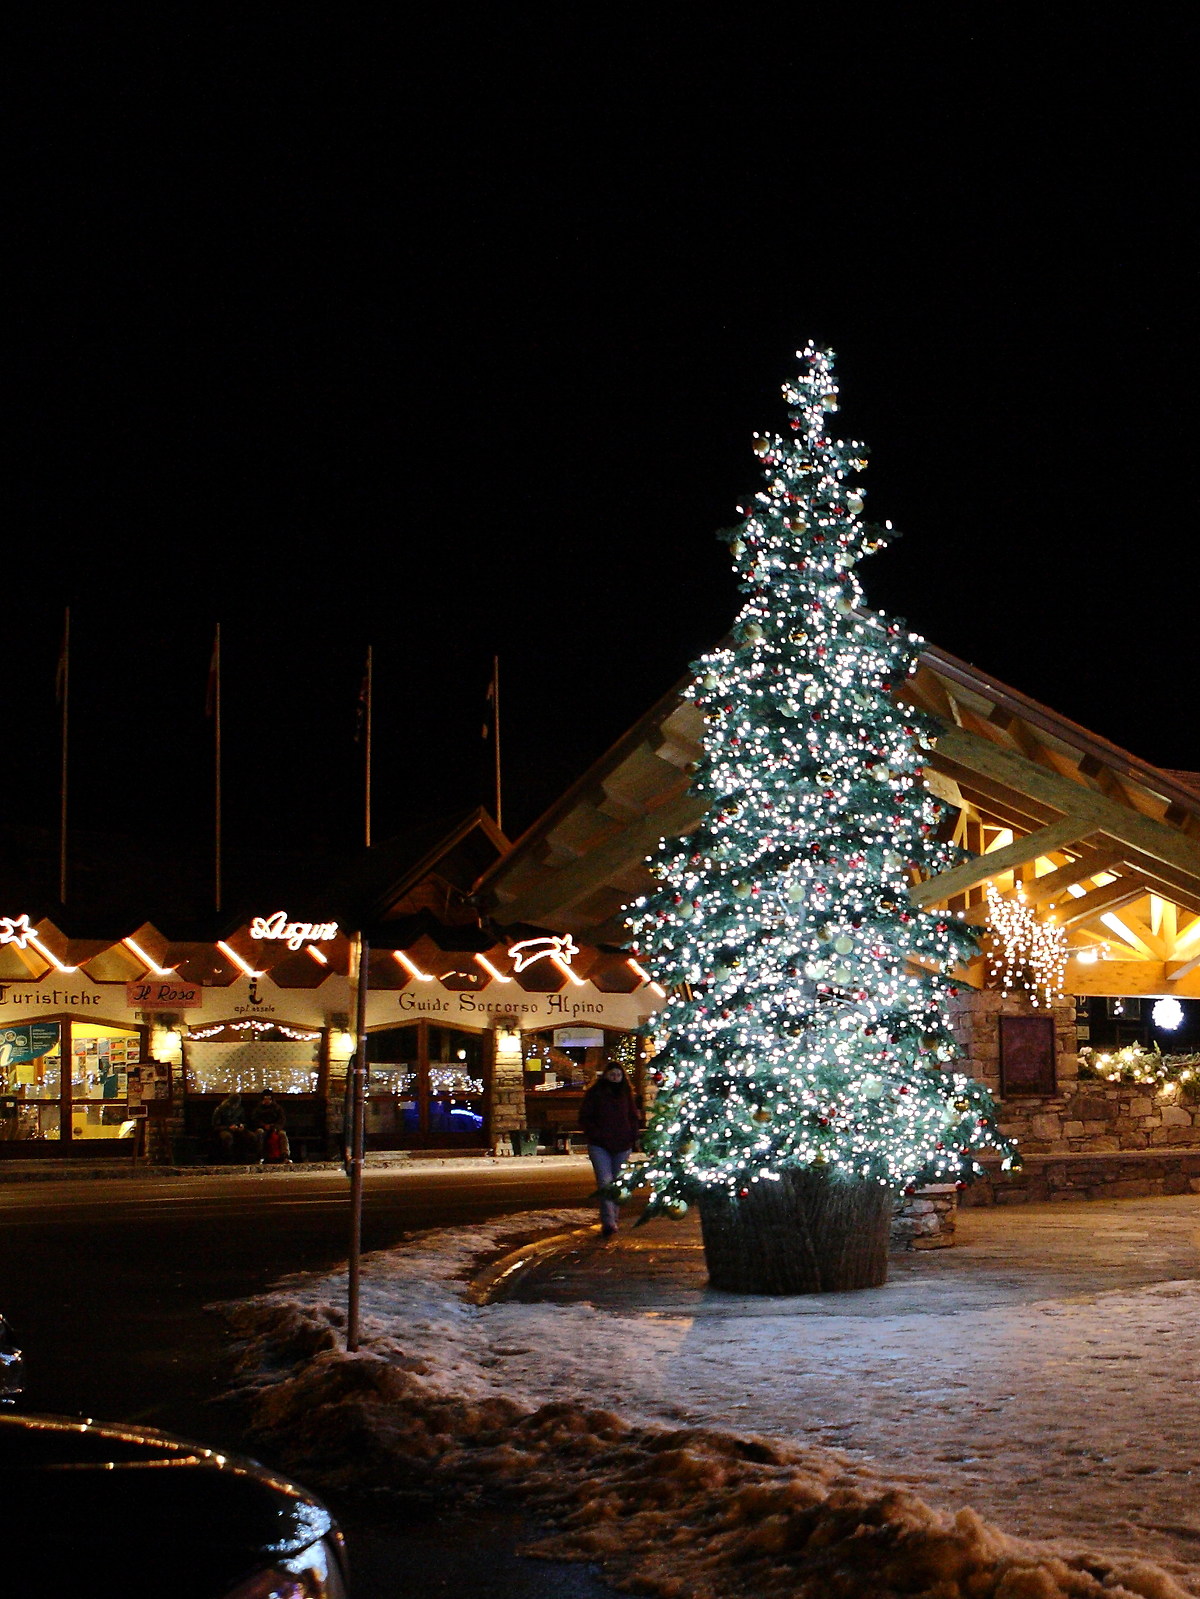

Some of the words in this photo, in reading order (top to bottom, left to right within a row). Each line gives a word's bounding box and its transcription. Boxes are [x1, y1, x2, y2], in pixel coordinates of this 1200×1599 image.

[158, 985, 195, 1001] Rosa
[399, 992, 450, 1011] Guide
[459, 993, 538, 1013] Soccorso
[546, 994, 604, 1017] Alpino
